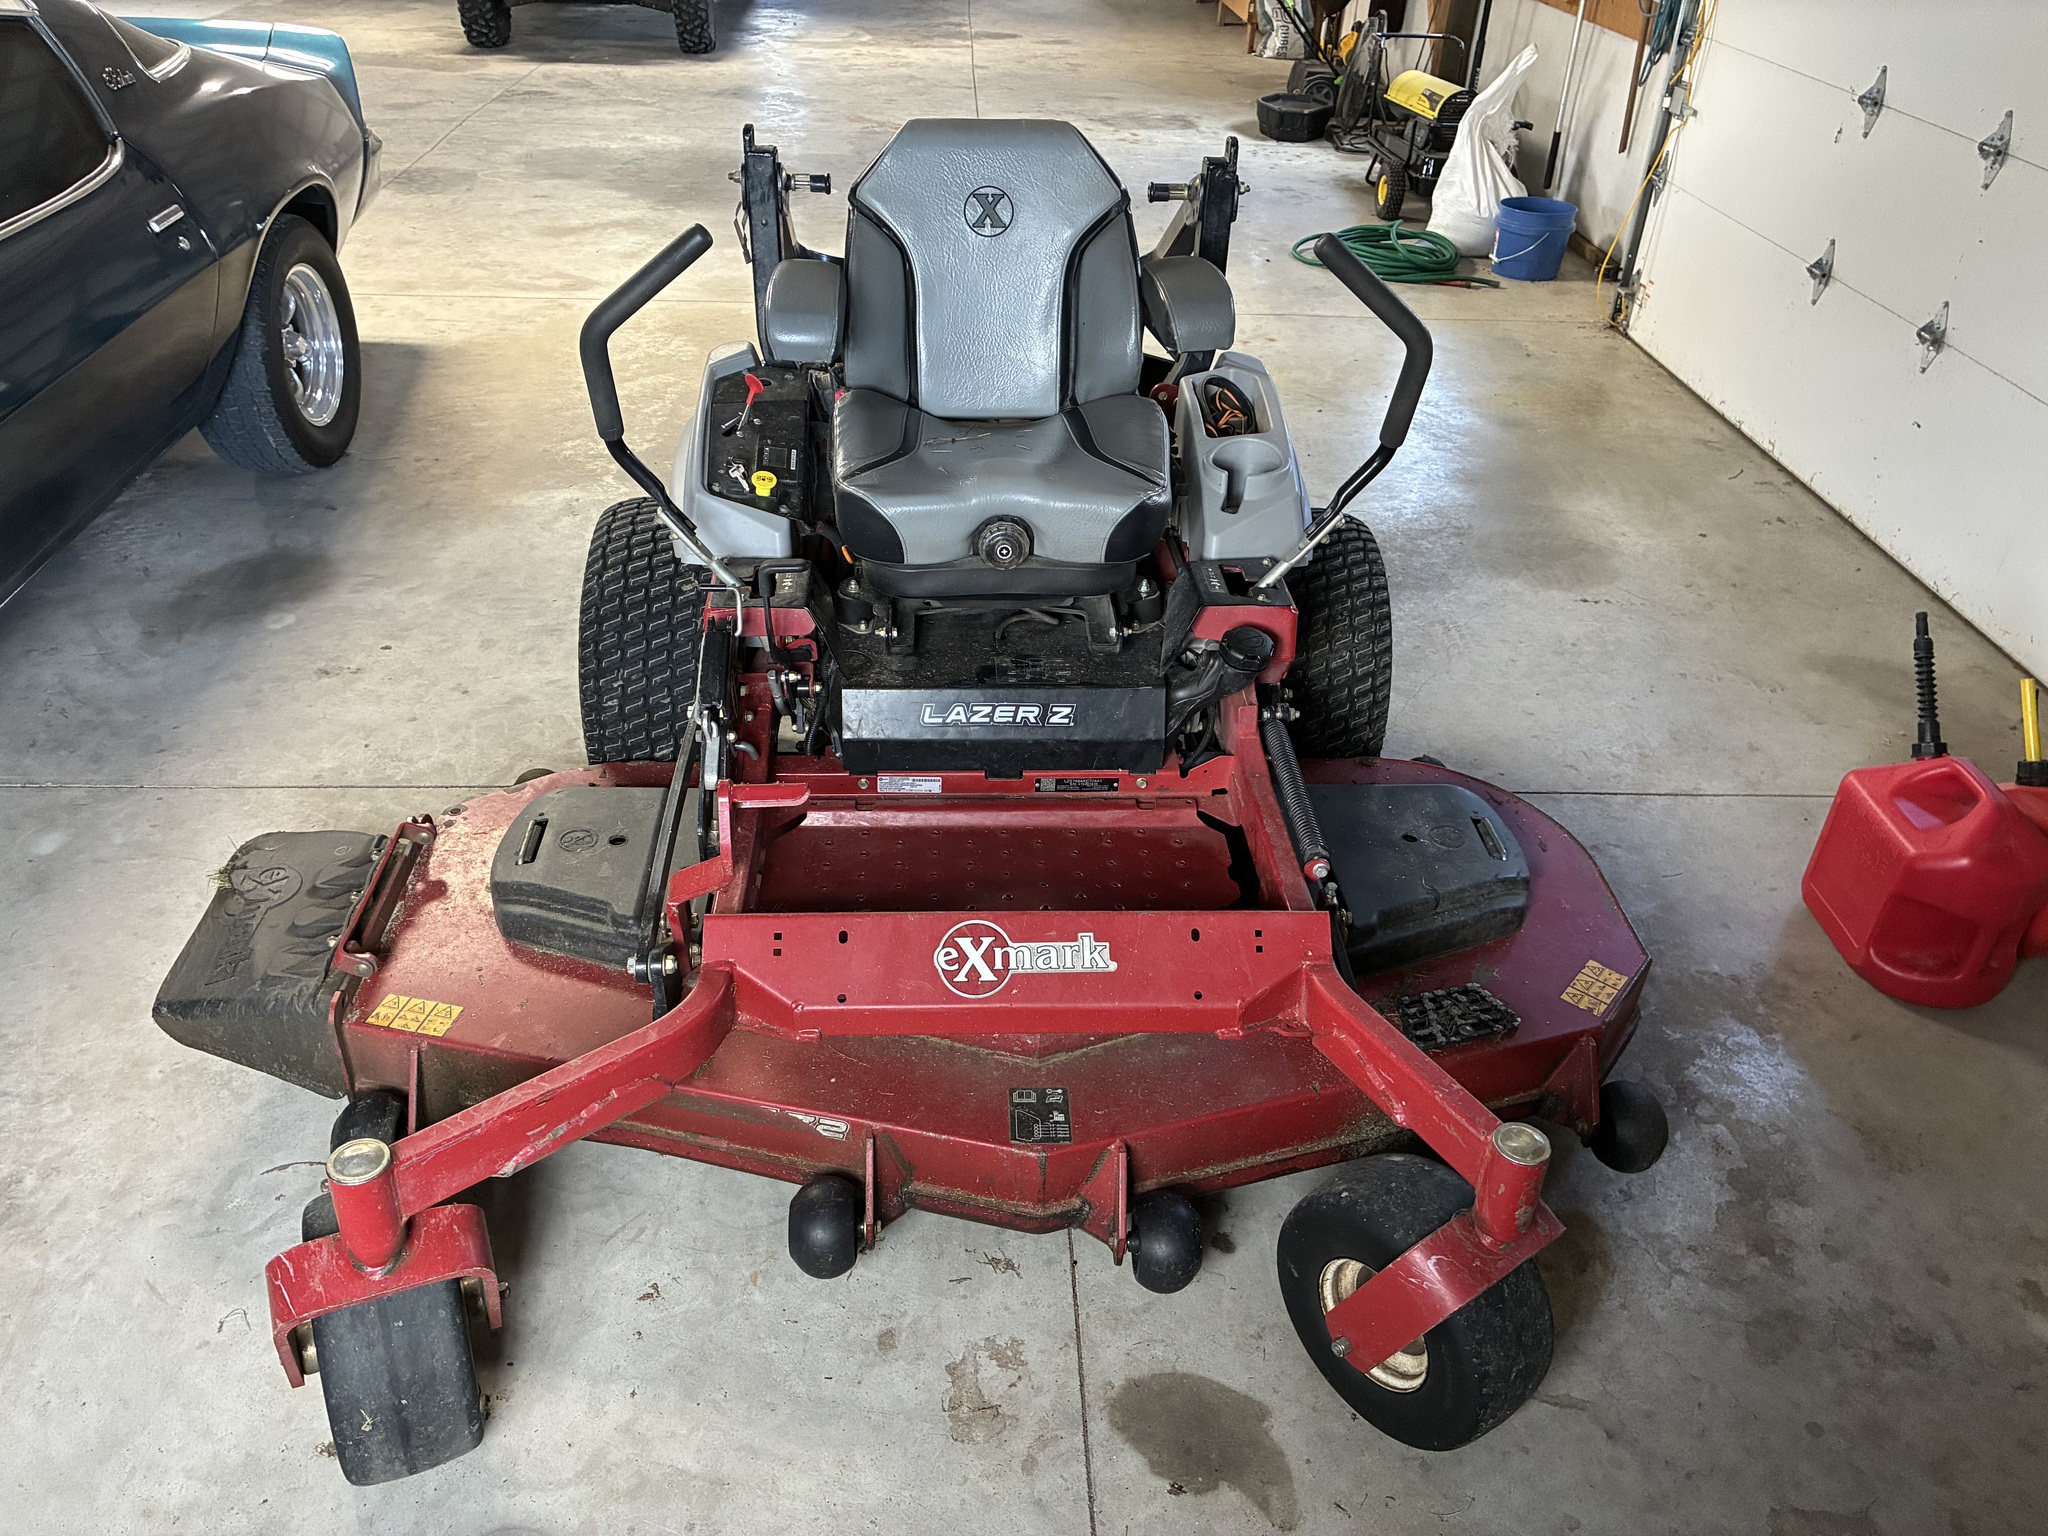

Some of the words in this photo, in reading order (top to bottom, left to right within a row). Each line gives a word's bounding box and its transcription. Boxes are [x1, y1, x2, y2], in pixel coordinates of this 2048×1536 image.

[1276, 25, 1290, 58] CUBES
[972, 193, 1007, 229] X
[921, 704, 1040, 725] LAZER
[1047, 704, 1075, 725] Z
[936, 935, 1109, 983] eXmark
